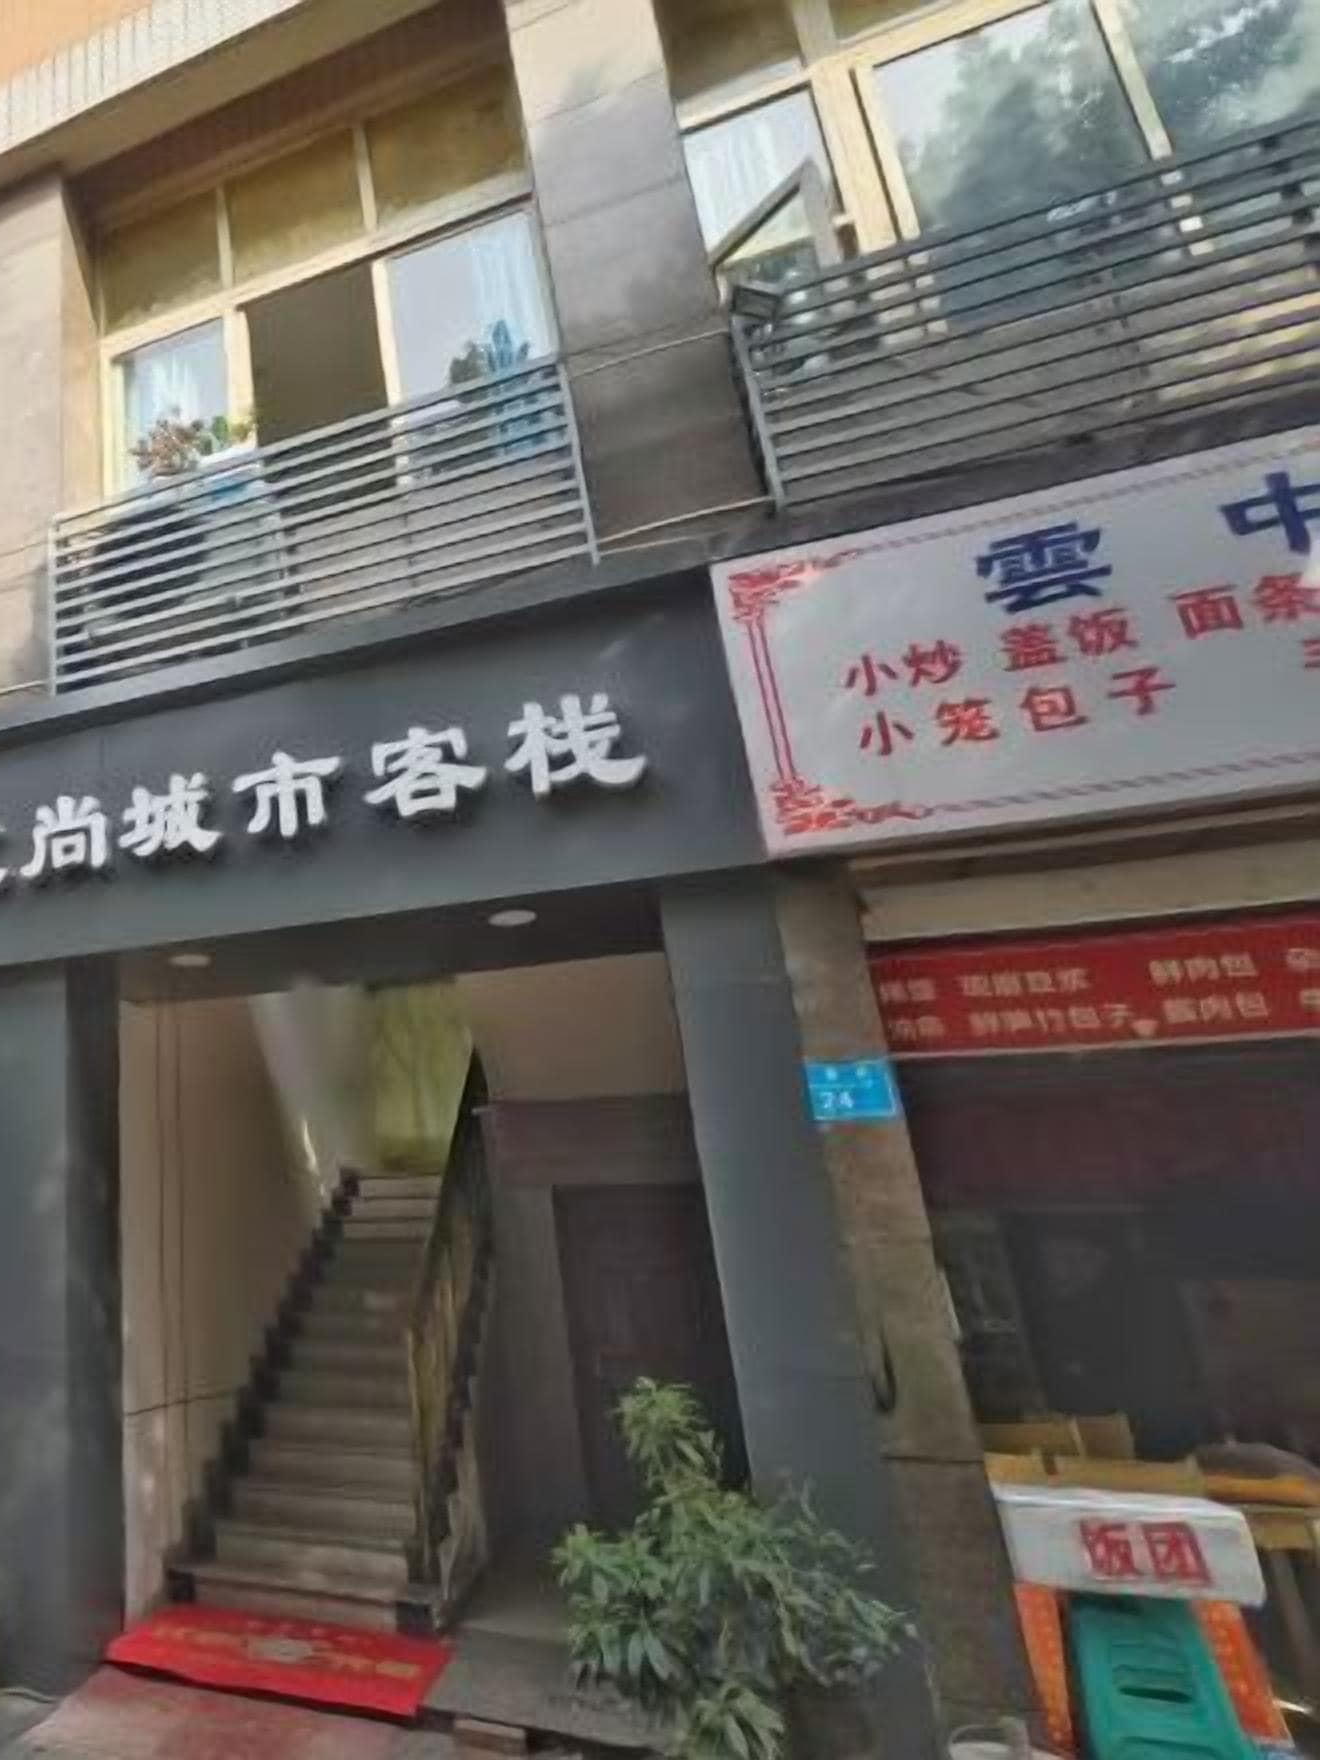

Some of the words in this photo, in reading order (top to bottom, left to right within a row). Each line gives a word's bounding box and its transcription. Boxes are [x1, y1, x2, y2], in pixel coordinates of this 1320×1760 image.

[844, 639, 964, 698] 小炒
[1000, 607, 1141, 673] 盖饭
[858, 666, 1178, 758] 小笼包子
